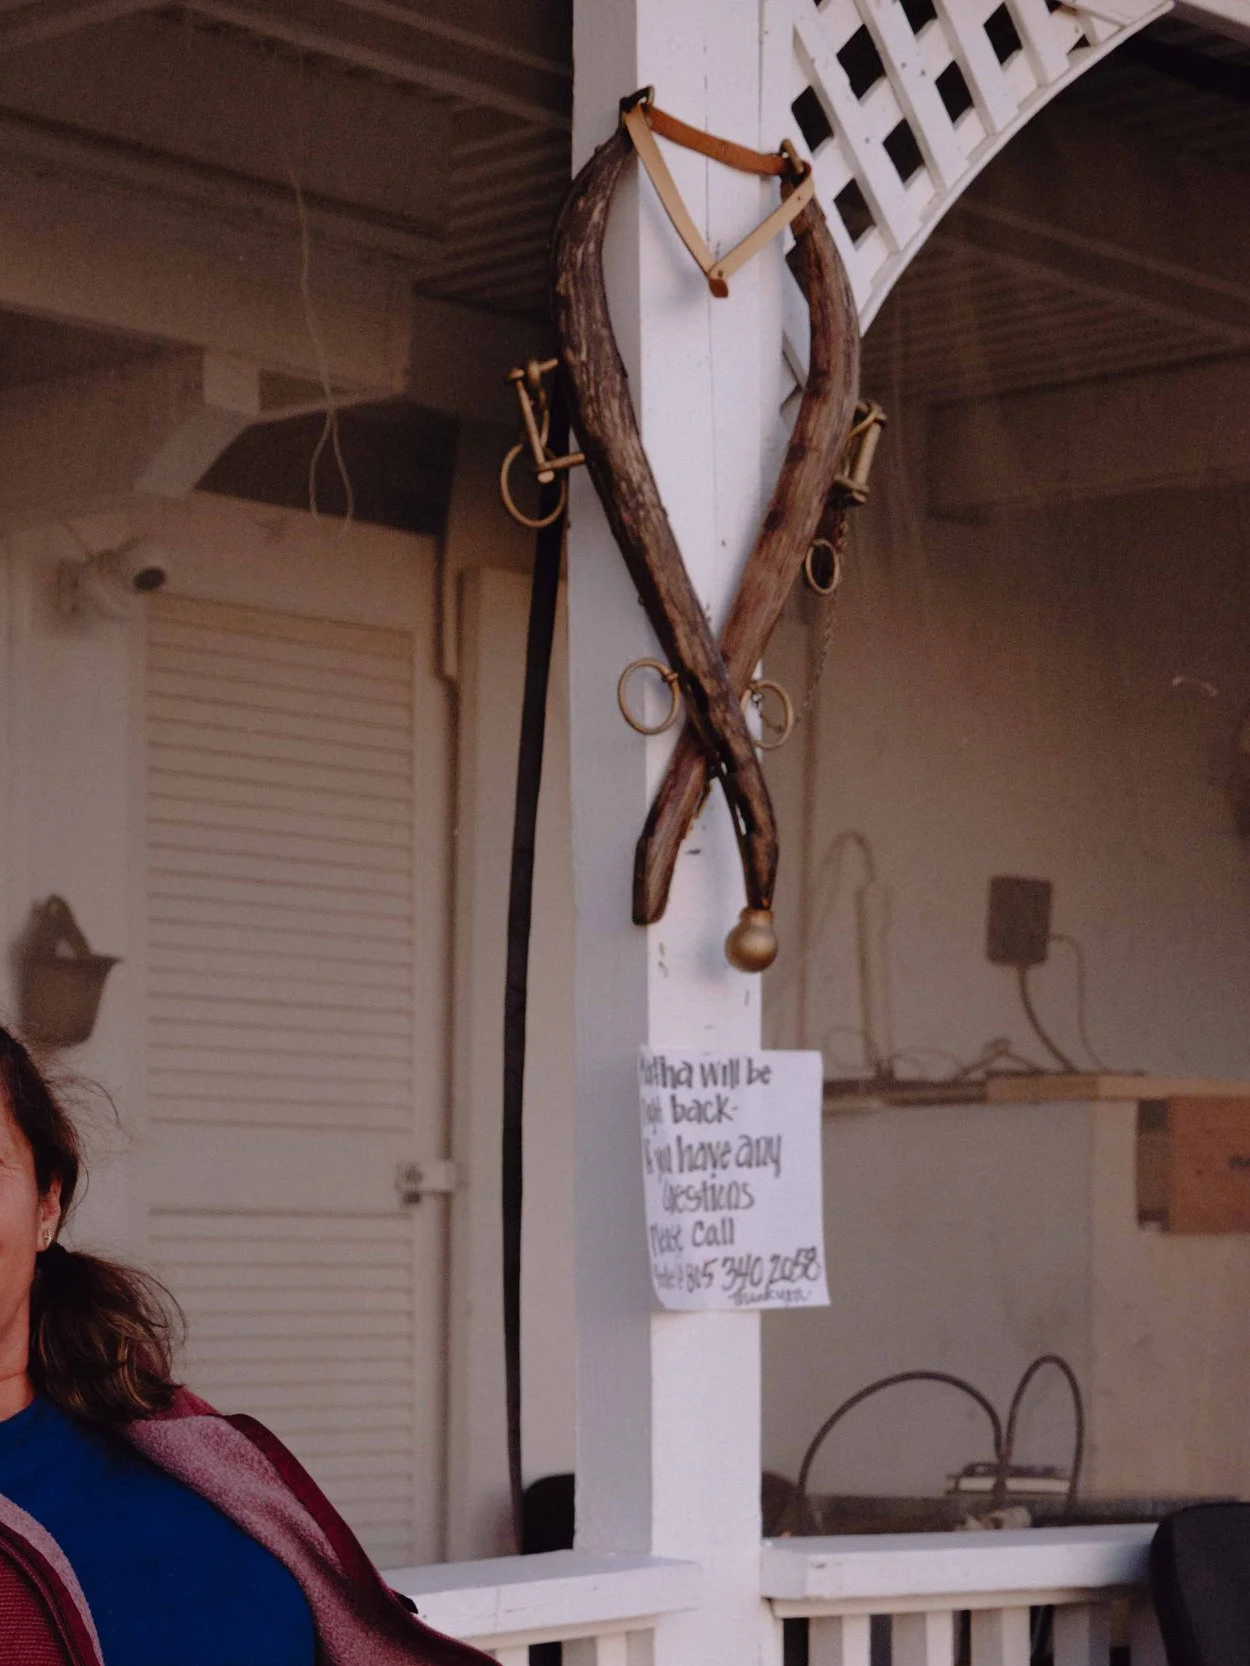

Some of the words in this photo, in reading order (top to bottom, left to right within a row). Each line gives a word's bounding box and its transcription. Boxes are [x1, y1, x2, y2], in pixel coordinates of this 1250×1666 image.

[746, 1056, 771, 1085] be
[676, 1135, 732, 1173] have
[734, 1134, 782, 1178] any
